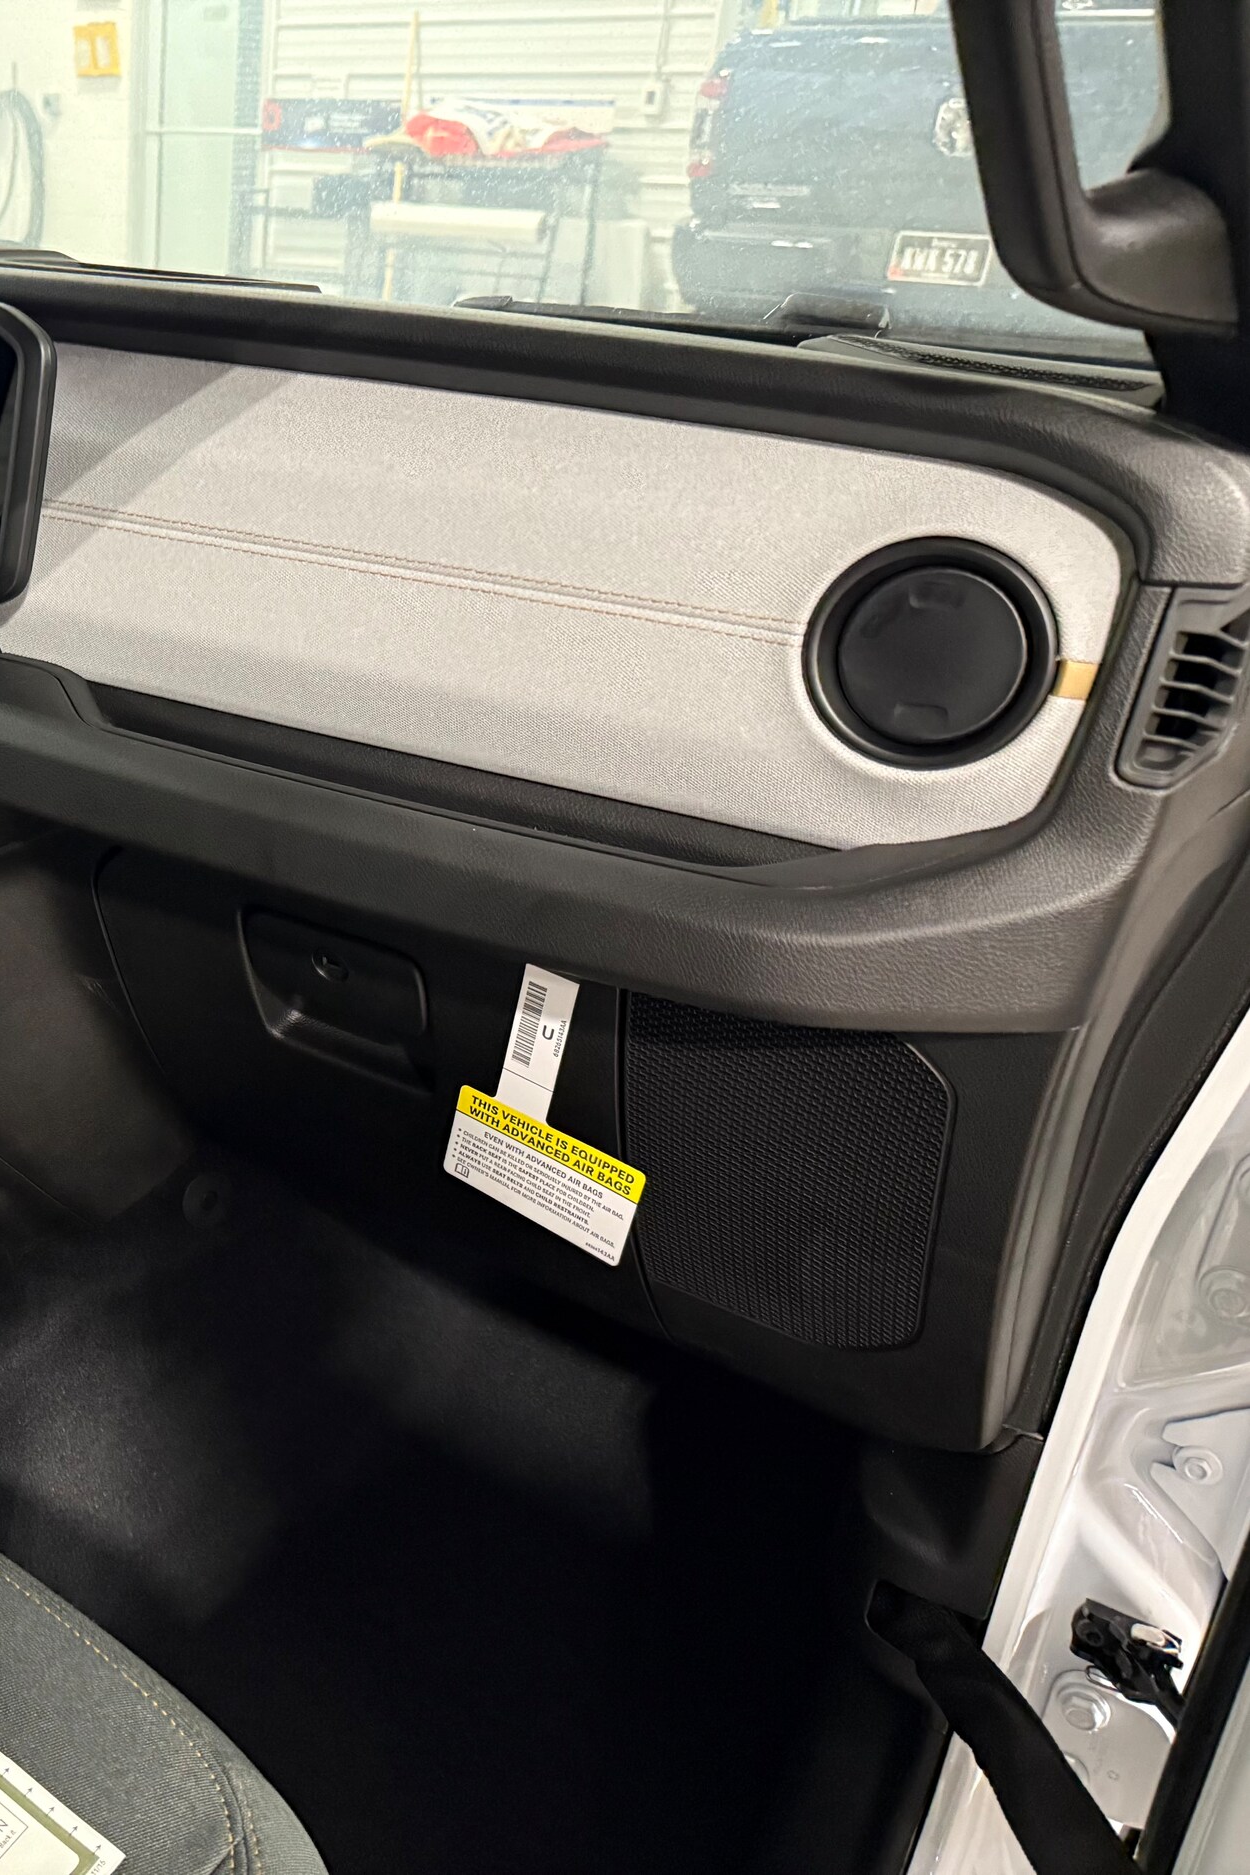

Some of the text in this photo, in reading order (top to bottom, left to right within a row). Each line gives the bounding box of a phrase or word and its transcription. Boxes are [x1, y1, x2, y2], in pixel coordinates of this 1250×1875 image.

[469, 1105, 631, 1195] WITH ADVANCED AIR BAGS
[471, 1095, 634, 1183] THIS VEHICLE IS EQUIPPED
[484, 1131, 602, 1198] EVEN WITH ADVANCED AIR BAGS
